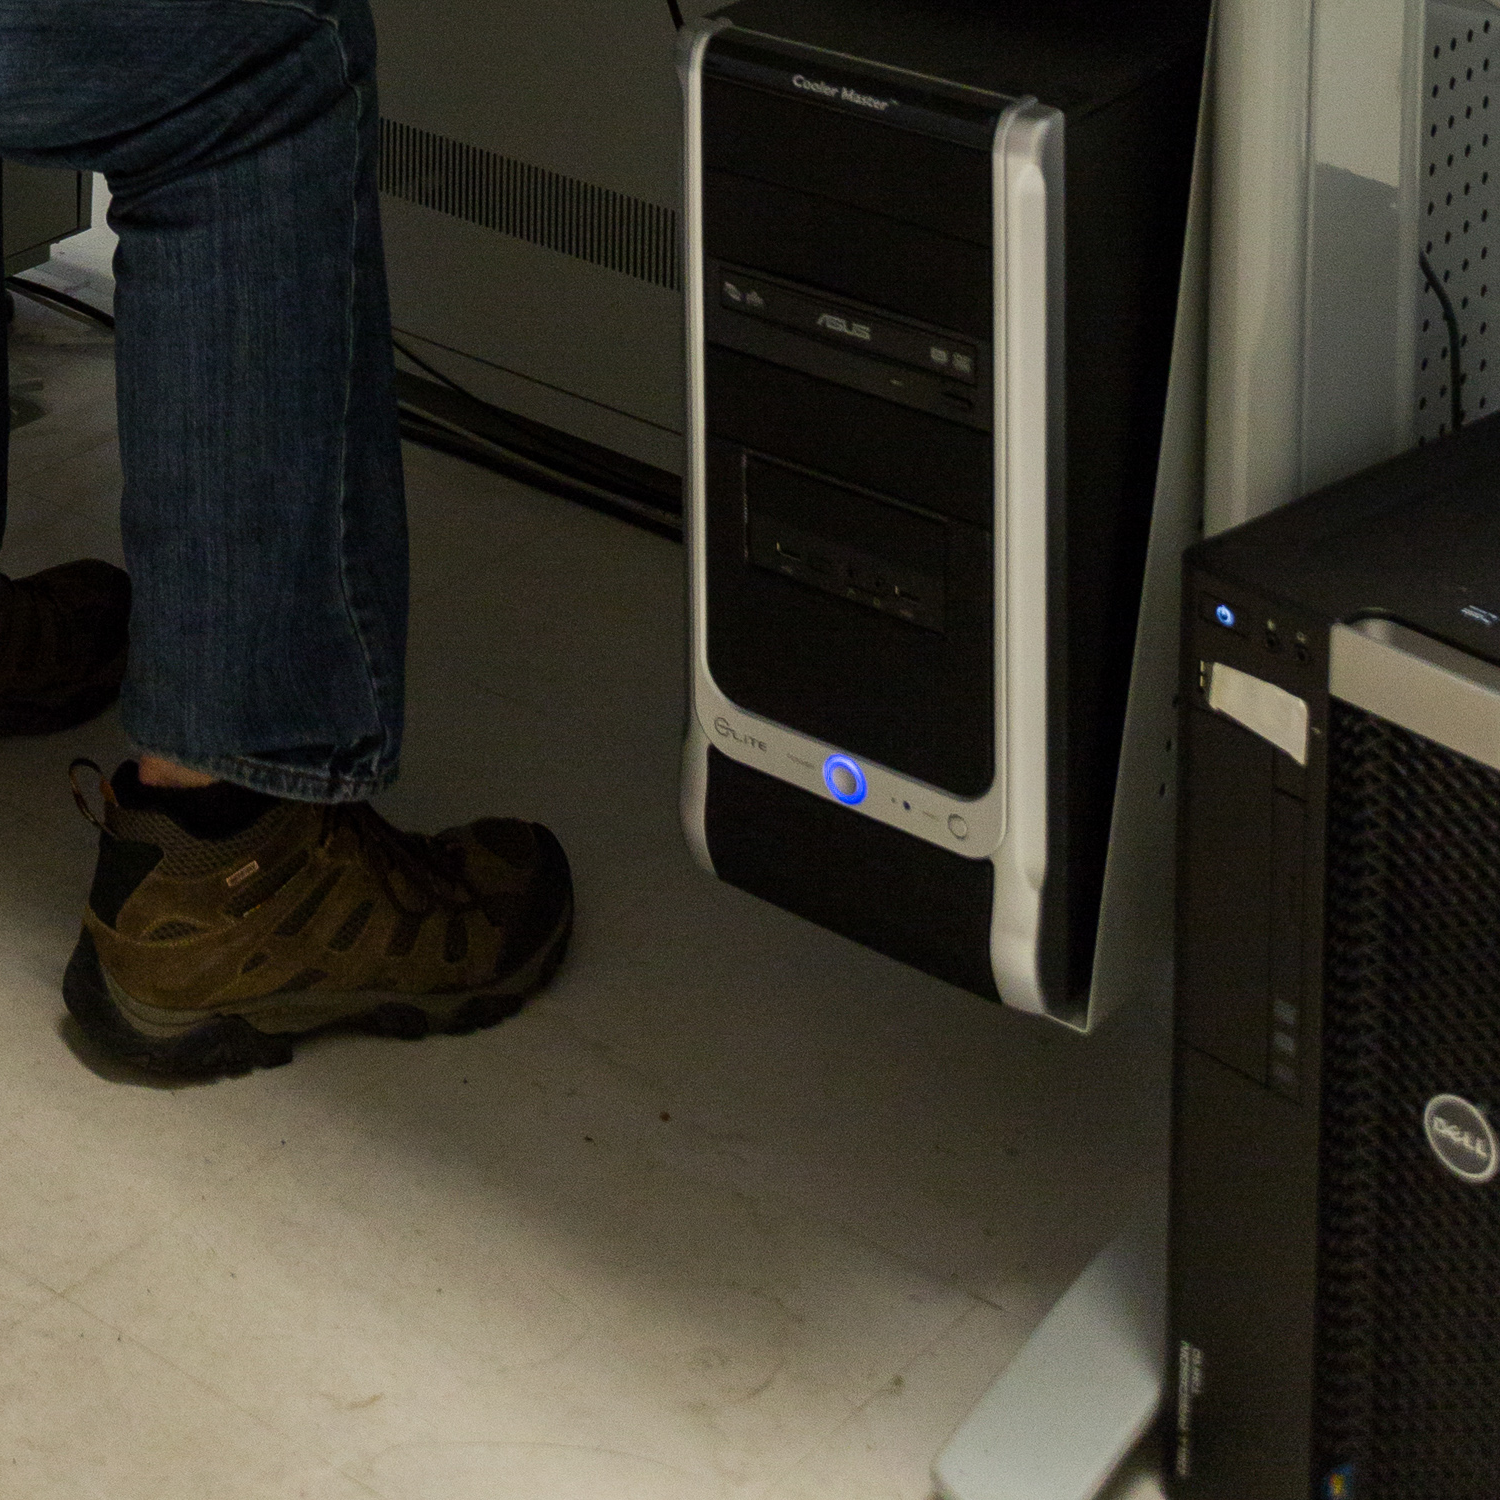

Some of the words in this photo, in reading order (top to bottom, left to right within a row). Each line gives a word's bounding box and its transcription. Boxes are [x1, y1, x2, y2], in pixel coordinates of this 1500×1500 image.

[792, 74, 839, 97] Cooler
[841, 86, 888, 111] Master
[816, 313, 871, 340] ASUS
[1433, 1117, 1488, 1158] DELL
